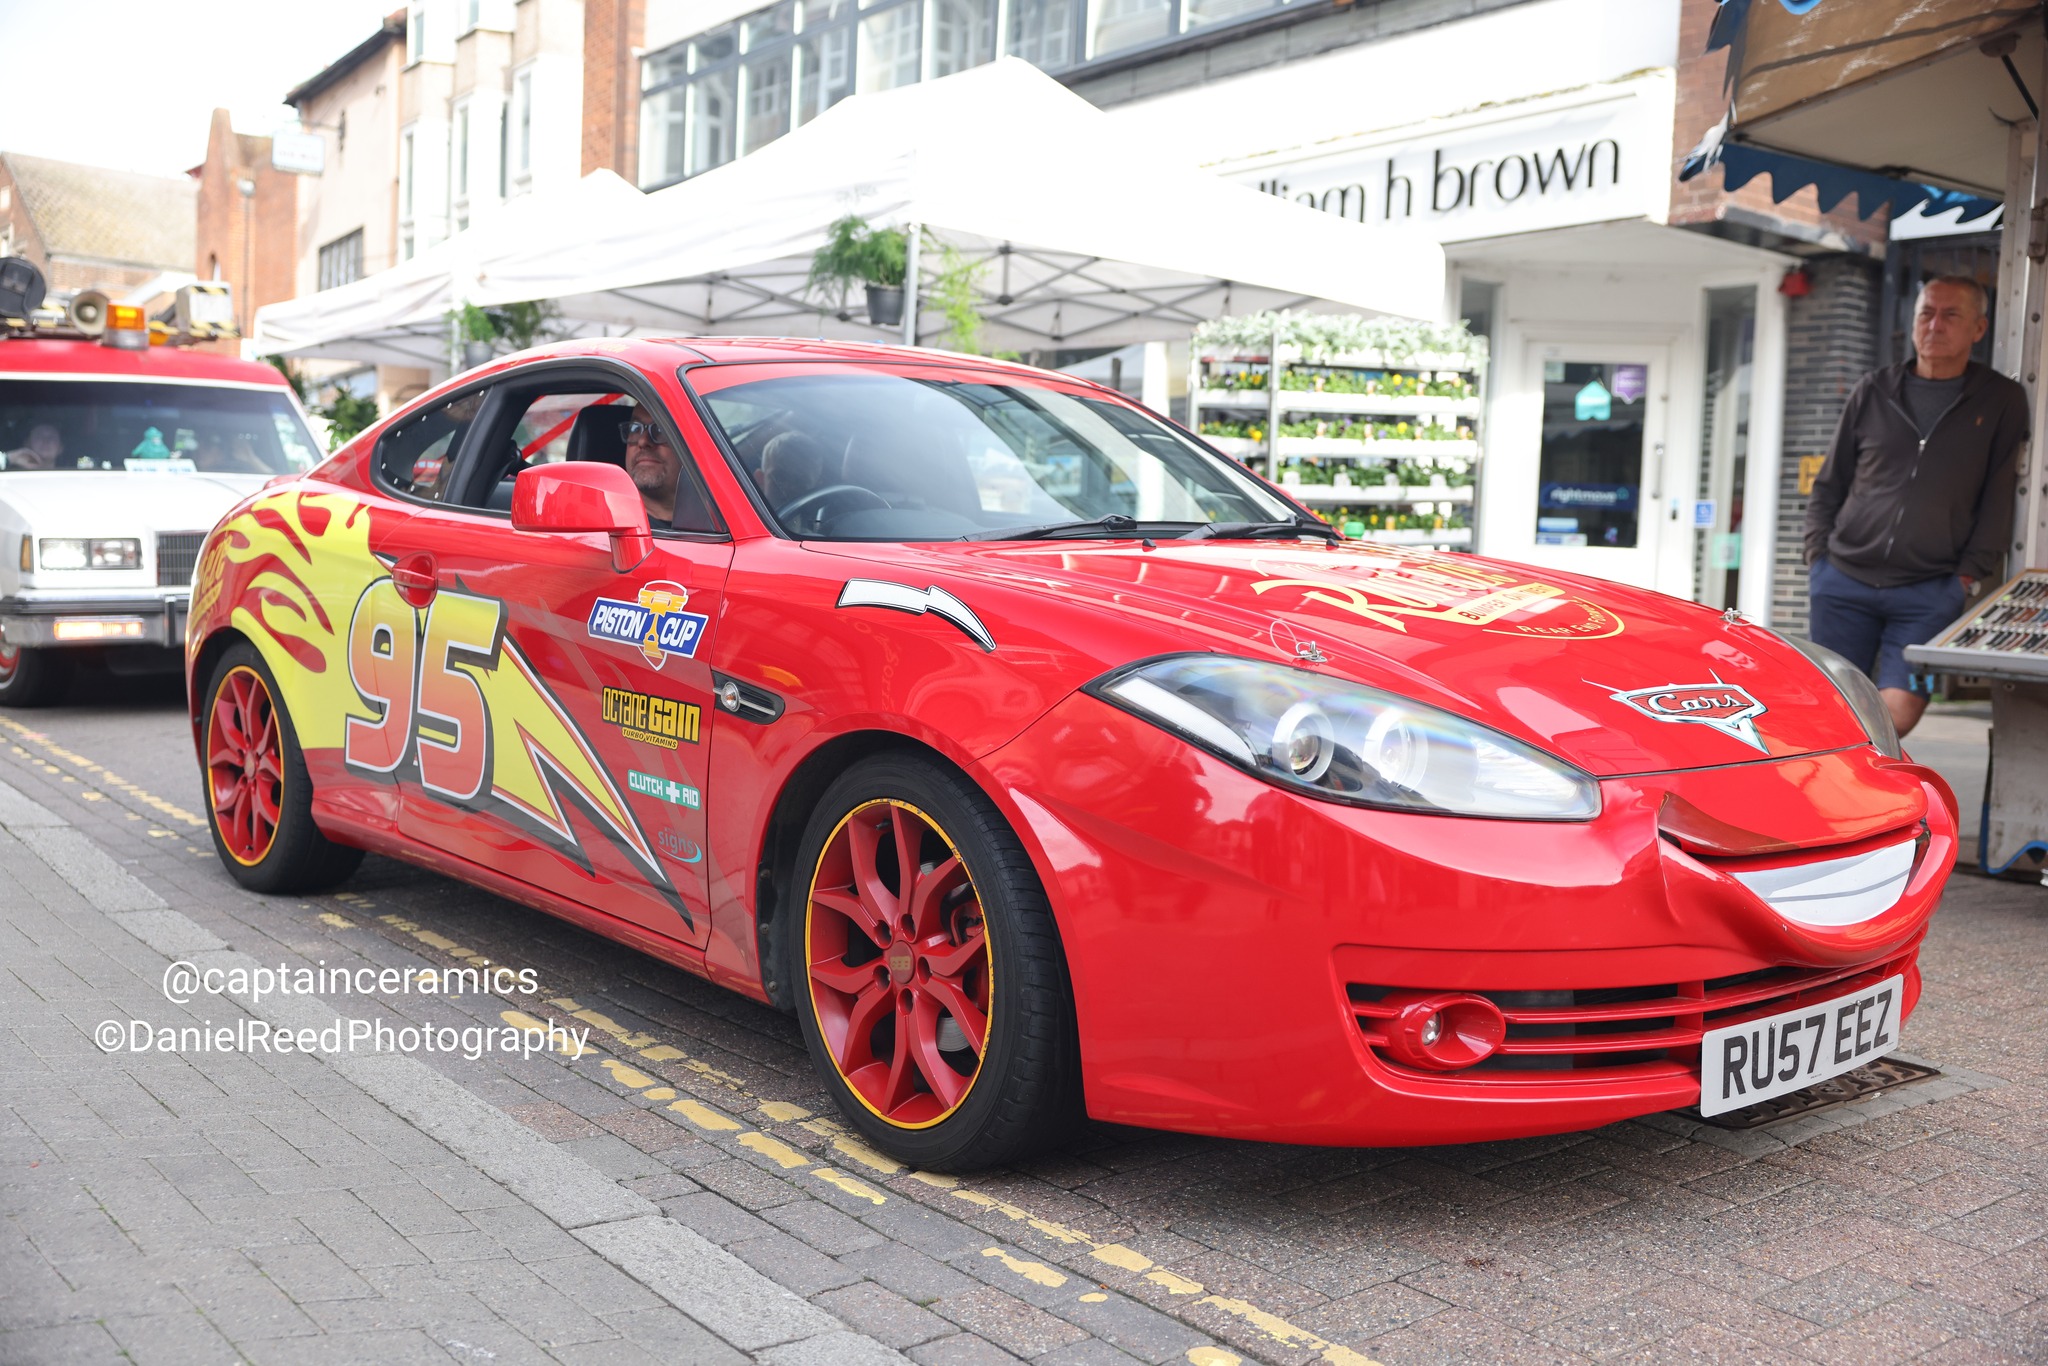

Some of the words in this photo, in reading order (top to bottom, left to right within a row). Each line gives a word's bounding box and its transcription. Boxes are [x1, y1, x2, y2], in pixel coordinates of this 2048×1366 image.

[1384, 158, 1412, 220] h
[1431, 138, 1620, 213] brown
[592, 604, 648, 640] PISTON
[659, 617, 698, 648] CUP
[345, 577, 501, 801] 95
[1647, 693, 1750, 714] Cars
[622, 728, 644, 741] TURBO
[645, 734, 677, 749] VITAMINS
[629, 771, 664, 797] CLUTCH
[682, 787, 699, 807] AID
[657, 828, 694, 855] signs
[1722, 1012, 1827, 1100] RU57
[1833, 988, 1893, 1065] EEZ
